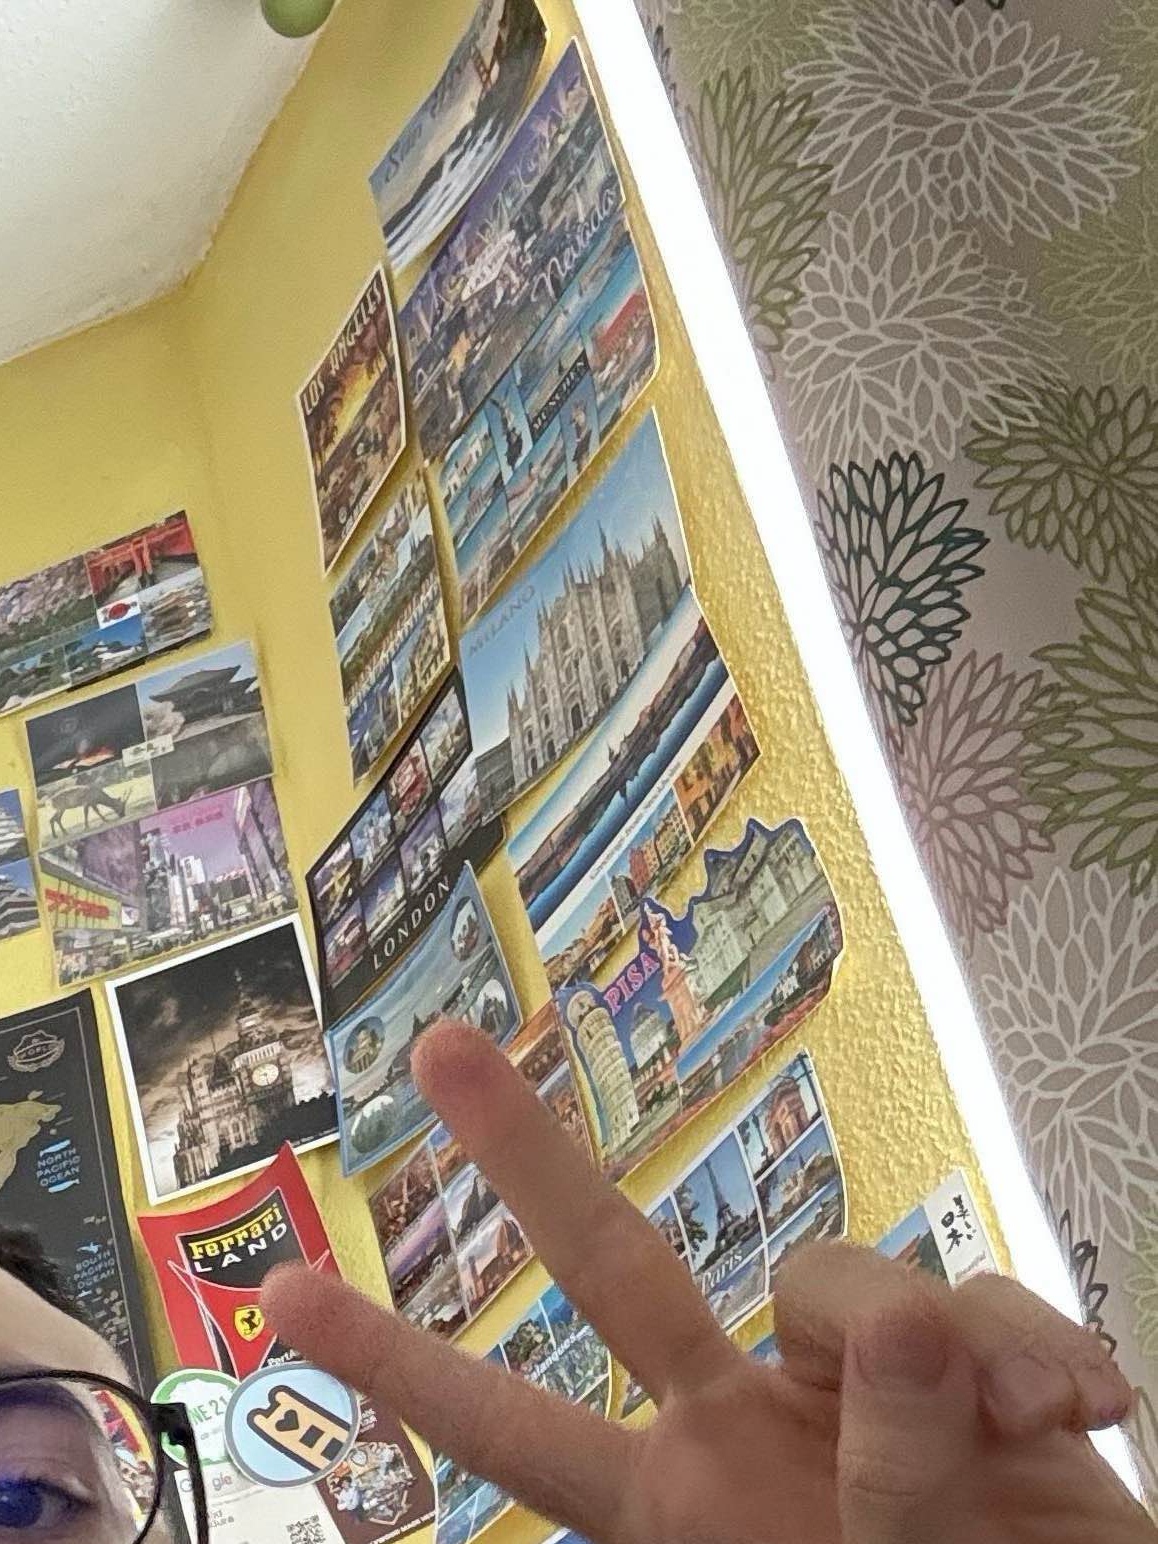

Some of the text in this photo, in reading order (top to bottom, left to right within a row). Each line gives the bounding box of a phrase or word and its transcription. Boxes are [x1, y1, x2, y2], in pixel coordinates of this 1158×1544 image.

[530, 187, 617, 303] Nevada
[302, 280, 383, 416] LOS ANGELES
[468, 584, 536, 657] MILANO
[372, 874, 451, 971] LONDON
[603, 951, 661, 1018] PISA
[36, 1155, 81, 1178] PACIFIC
[37, 1147, 76, 1169] NORTH
[40, 1166, 80, 1187] OCEAN
[188, 1201, 283, 1260] Ferrari
[194, 1222, 289, 1274] LAND
[940, 1211, 965, 1255] 日本
[73, 1258, 116, 1283] PACIFIC
[76, 1249, 111, 1271] SOUTH
[77, 1268, 116, 1290] OCEAN
[703, 1250, 743, 1292] Paris
[529, 1331, 577, 1381] alanques
[180, 1470, 233, 1493] Ggle
